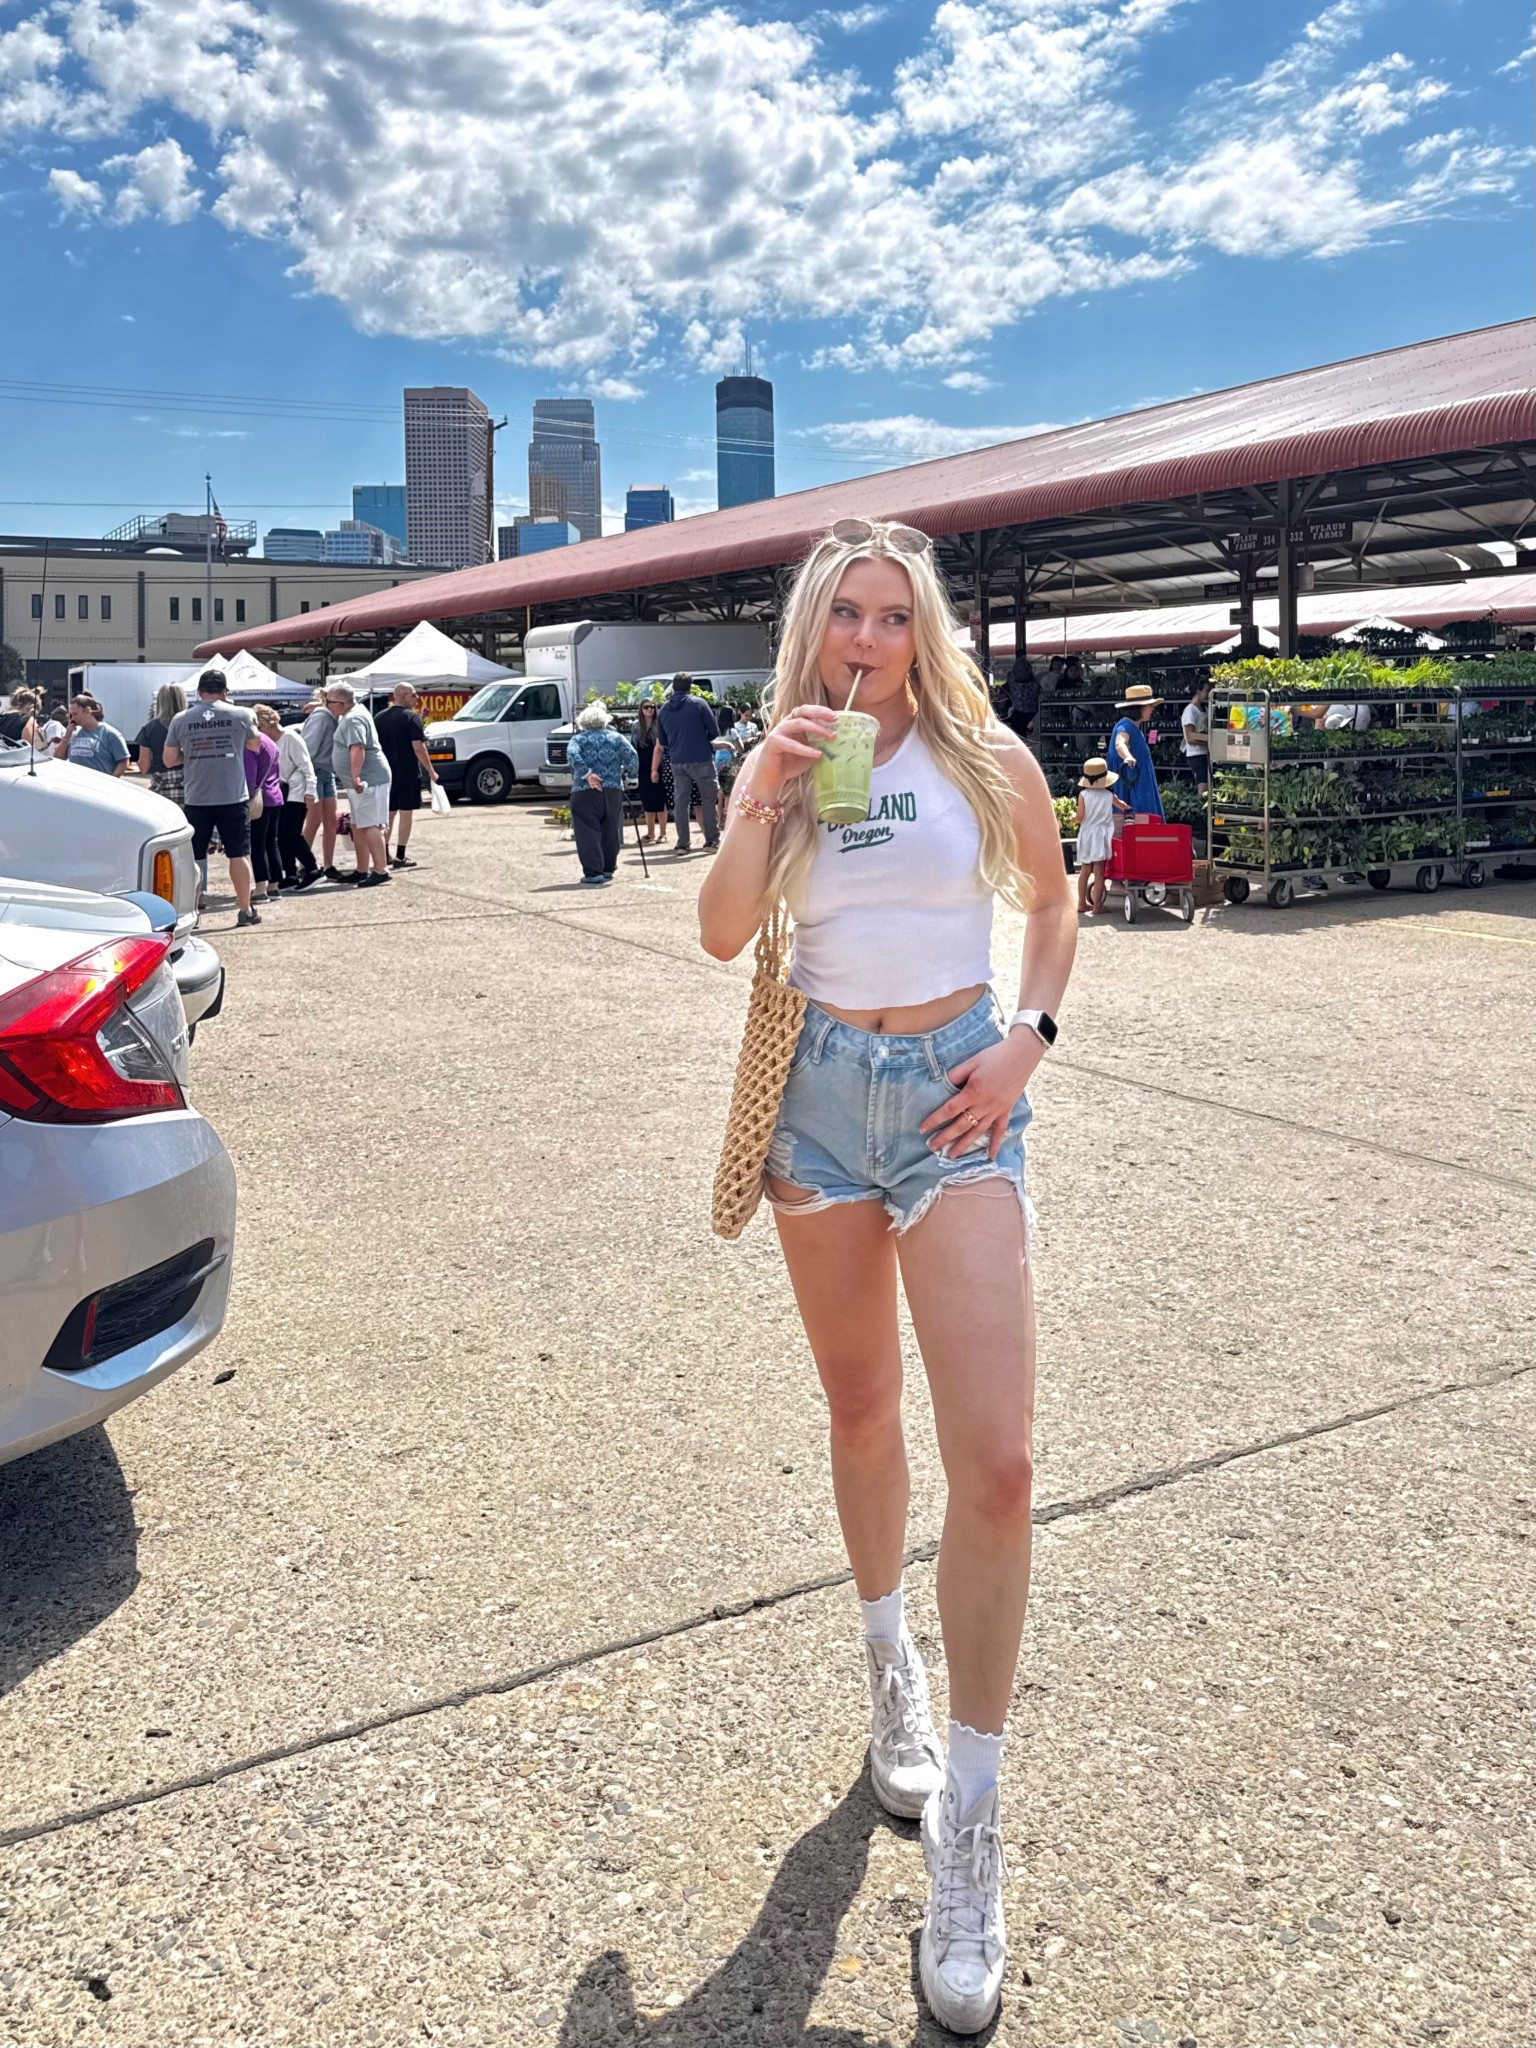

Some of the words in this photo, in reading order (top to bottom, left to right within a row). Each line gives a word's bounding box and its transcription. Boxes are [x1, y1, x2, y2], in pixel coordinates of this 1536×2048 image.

[1310, 522, 1346, 533] PFLAUM
[1233, 533, 1258, 544] PFLAUM
[1262, 534, 1276, 546] 334
[1289, 531, 1304, 542] 332
[1312, 530, 1344, 540] FARMS
[1235, 541, 1256, 552] FARMS
[413, 695, 463, 712] XICAN
[188, 719, 233, 731] FINISHER
[840, 826, 893, 848] Oregon
